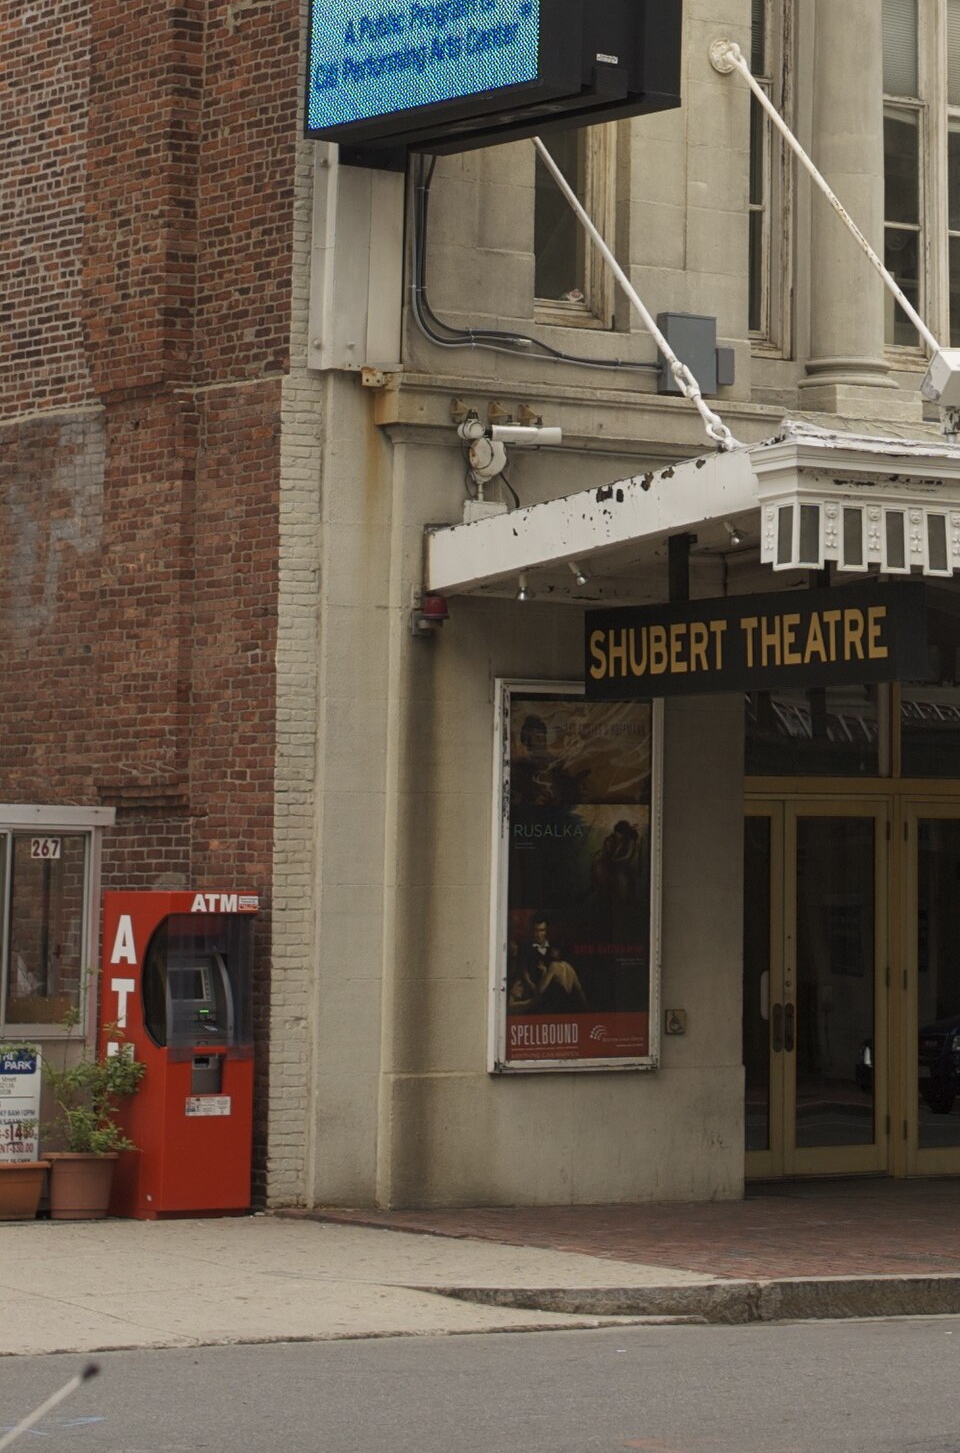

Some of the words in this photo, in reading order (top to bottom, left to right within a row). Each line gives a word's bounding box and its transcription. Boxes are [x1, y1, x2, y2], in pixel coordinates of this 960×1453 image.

[342, 45, 427, 83] Performing
[430, 35, 462, 63] Arts
[465, 22, 520, 55] Center
[589, 619, 728, 680] SHUBERT
[740, 605, 889, 668] THEATRE
[513, 823, 584, 838] RUSALKA
[32, 839, 59, 858] 267
[191, 893, 238, 913] ATM
[511, 1023, 579, 1046] SPELLBOUND
[5, 1060, 32, 1070] PARK
